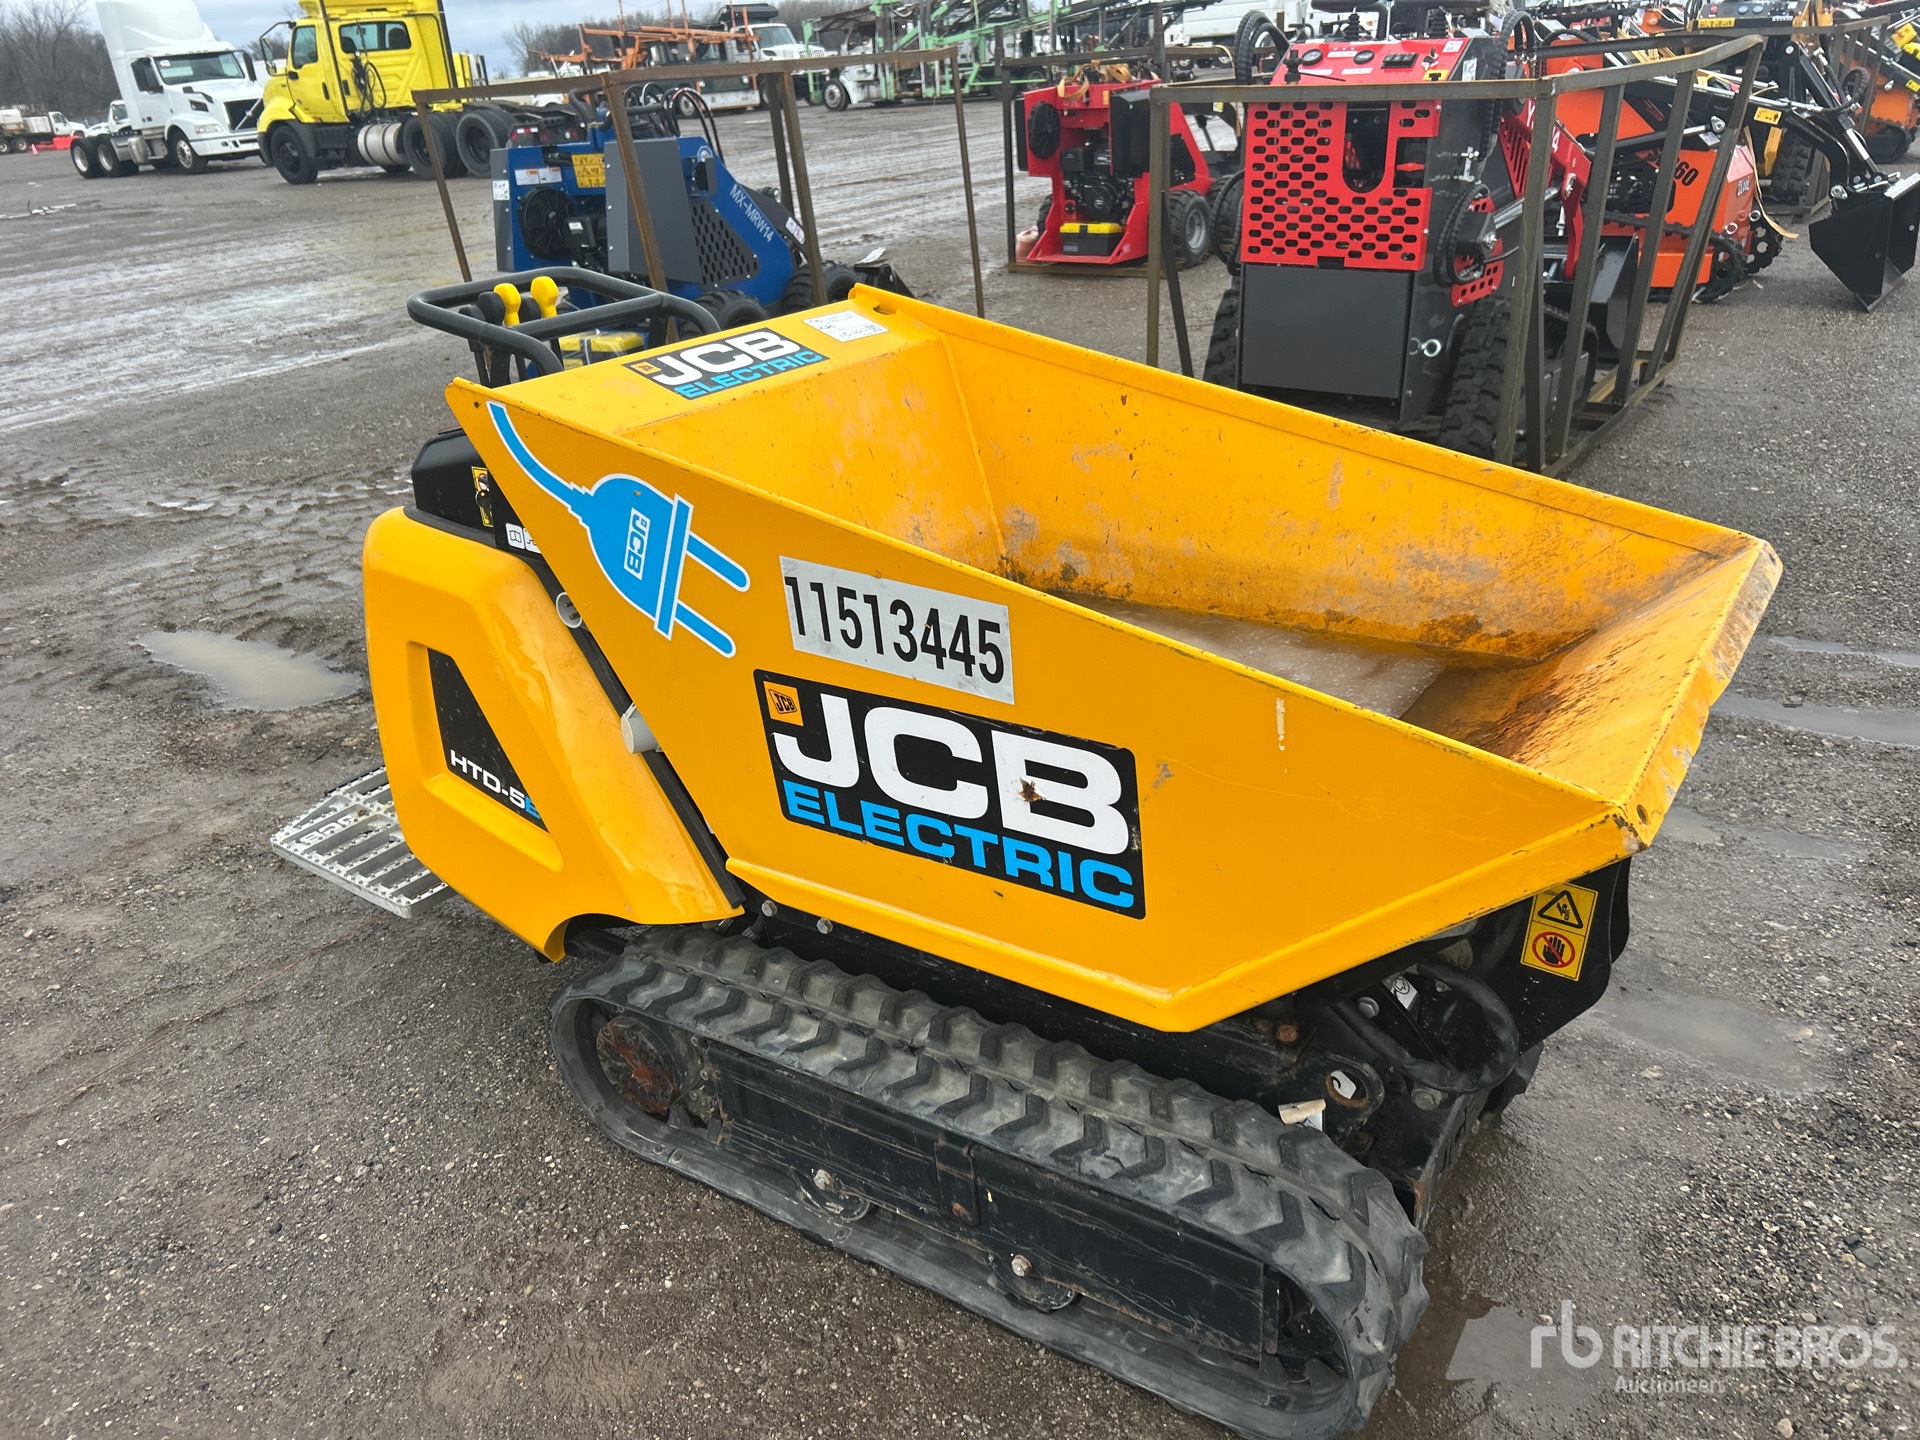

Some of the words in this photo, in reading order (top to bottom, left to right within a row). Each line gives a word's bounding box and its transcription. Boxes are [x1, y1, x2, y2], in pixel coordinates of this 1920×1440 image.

[730, 184, 774, 243] MX-MRW14
[651, 330, 802, 385] JCB
[674, 349, 824, 400] ELECTRIC
[627, 510, 649, 578] JCB
[784, 575, 1005, 685] 11513445
[771, 690, 798, 715] JCB
[450, 749, 542, 820] HTD-5E
[771, 693, 1130, 856] JCB
[299, 815, 353, 844] JCB
[783, 780, 1135, 909] ELECTRIC
